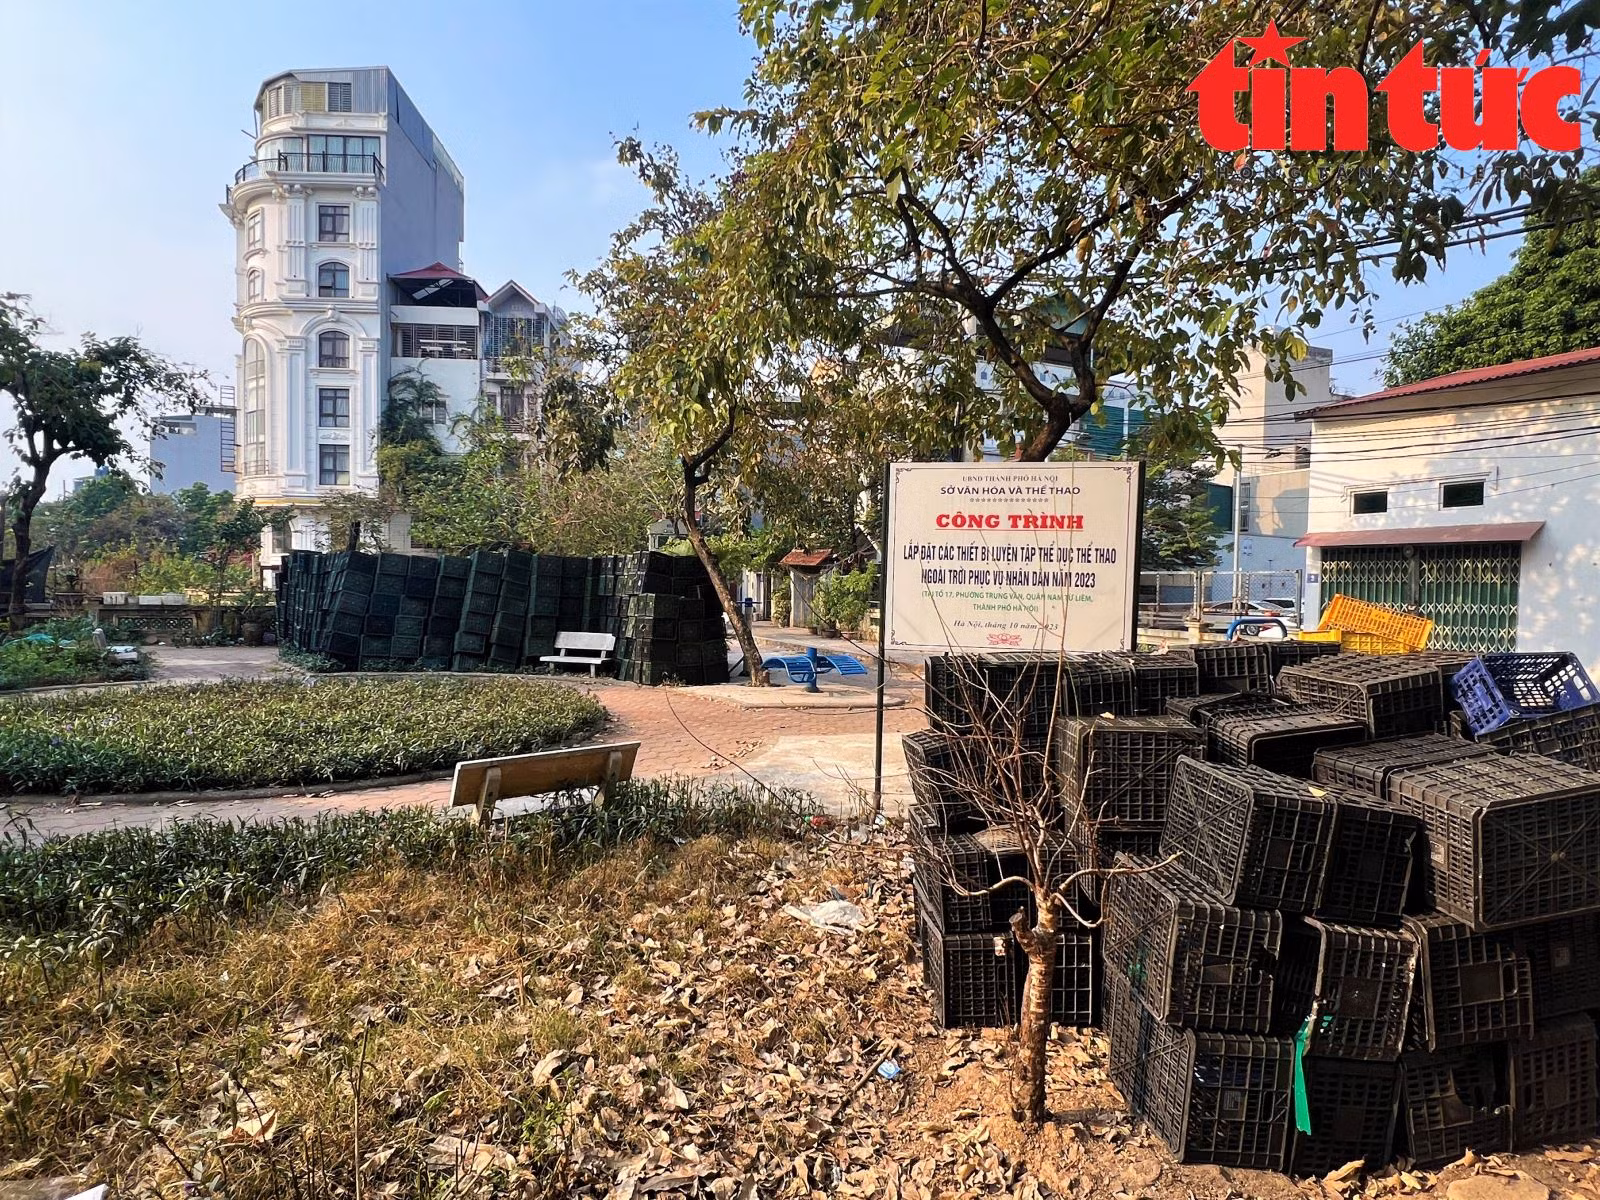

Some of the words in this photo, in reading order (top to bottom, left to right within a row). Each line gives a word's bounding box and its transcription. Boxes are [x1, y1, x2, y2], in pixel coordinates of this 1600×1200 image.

[940, 484, 956, 495] SỞ
[957, 485, 979, 495] VĂN
[982, 485, 1006, 495] HÓA
[1008, 485, 1023, 495] VÀ
[1050, 486, 1081, 495] THAO
[935, 511, 1000, 528] CÔNG
[1007, 512, 1084, 529] TRÌNH
[903, 539, 919, 560] LẮP
[938, 542, 955, 561] CÁC
[957, 540, 979, 561] THIẾT
[981, 545, 989, 565] BỊ
[991, 543, 1018, 566] LUYỆN
[1020, 543, 1036, 566] TẬP
[1095, 547, 1117, 564] THAO
[921, 565, 946, 584] NGOÀI
[948, 565, 966, 585] TRỜI
[968, 569, 990, 589] PHỤC
[993, 570, 1004, 589] VỤ
[1006, 567, 1029, 587] NHÂN
[1032, 567, 1050, 587] DÂN
[1052, 568, 1072, 587] NĂM
[1074, 572, 1096, 588] 2023
[985, 592, 1008, 600] TRUNG
[985, 621, 1007, 630] tháng
